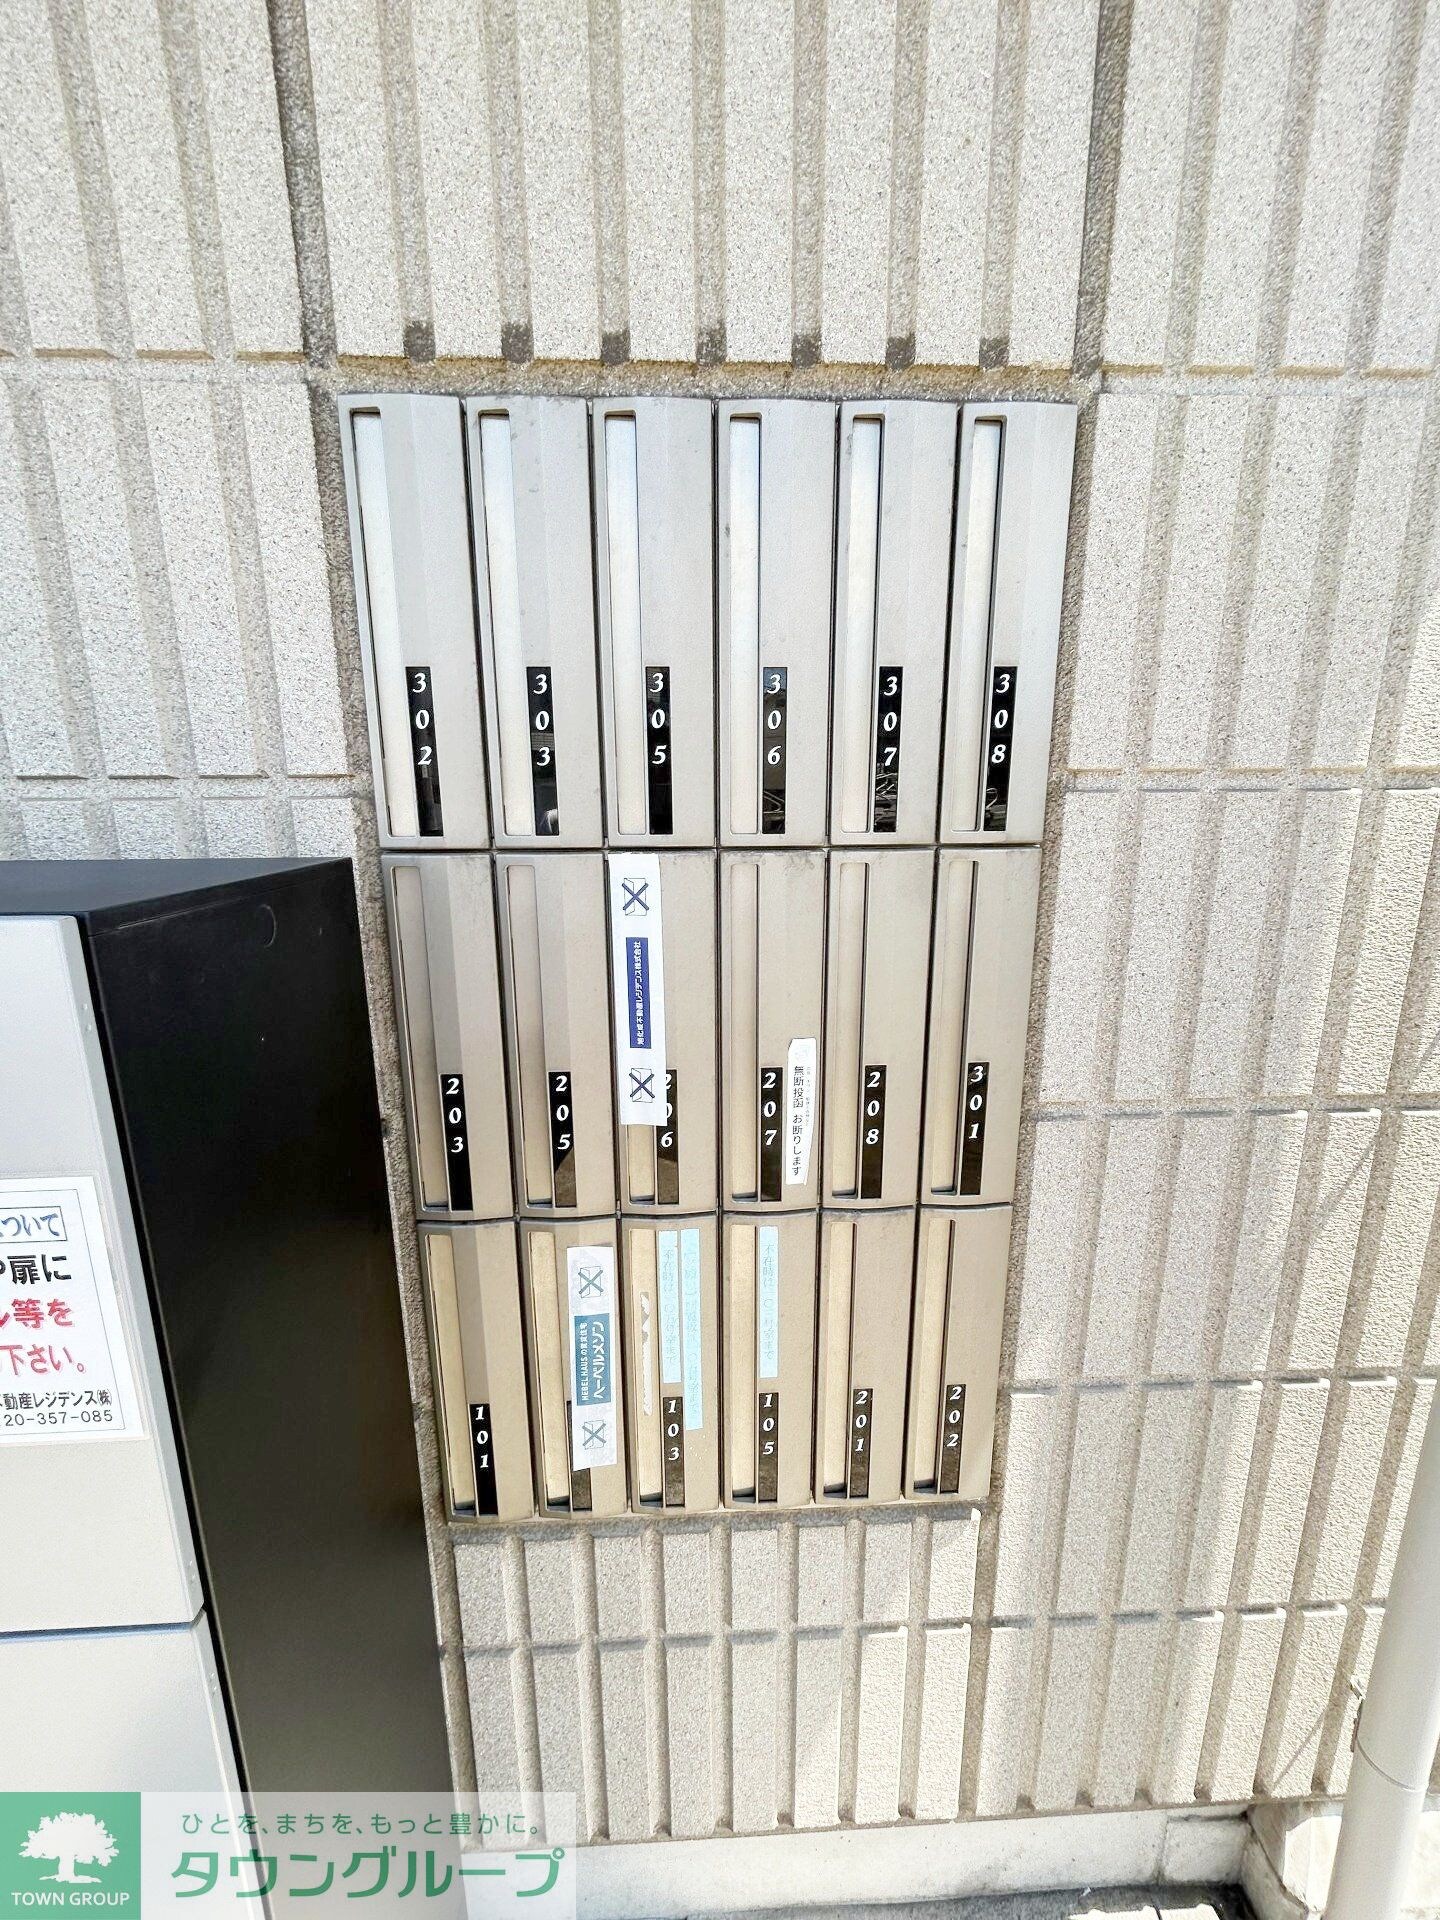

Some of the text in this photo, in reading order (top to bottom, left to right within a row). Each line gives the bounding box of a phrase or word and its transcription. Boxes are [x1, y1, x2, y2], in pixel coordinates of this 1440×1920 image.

[412, 672, 433, 766] 302
[533, 673, 551, 766] 303
[649, 672, 667, 765] 305
[766, 674, 782, 765] 306
[883, 675, 898, 766] 307
[991, 673, 1011, 764] 308
[445, 1077, 464, 1153] 203
[555, 1075, 571, 1150] 205
[762, 1072, 777, 1146] 207
[865, 1071, 880, 1145] 208
[967, 1065, 984, 1139] 301
[0, 1212, 60, 1238] ついて
[0, 1253, 72, 1285] 扉に
[0, 1409, 113, 1427] 20-357-085
[474, 1406, 489, 1468] 101
[667, 1400, 680, 1461] 103
[762, 1394, 775, 1455] 105
[854, 1390, 867, 1451] 201
[946, 1386, 961, 1448] 202
